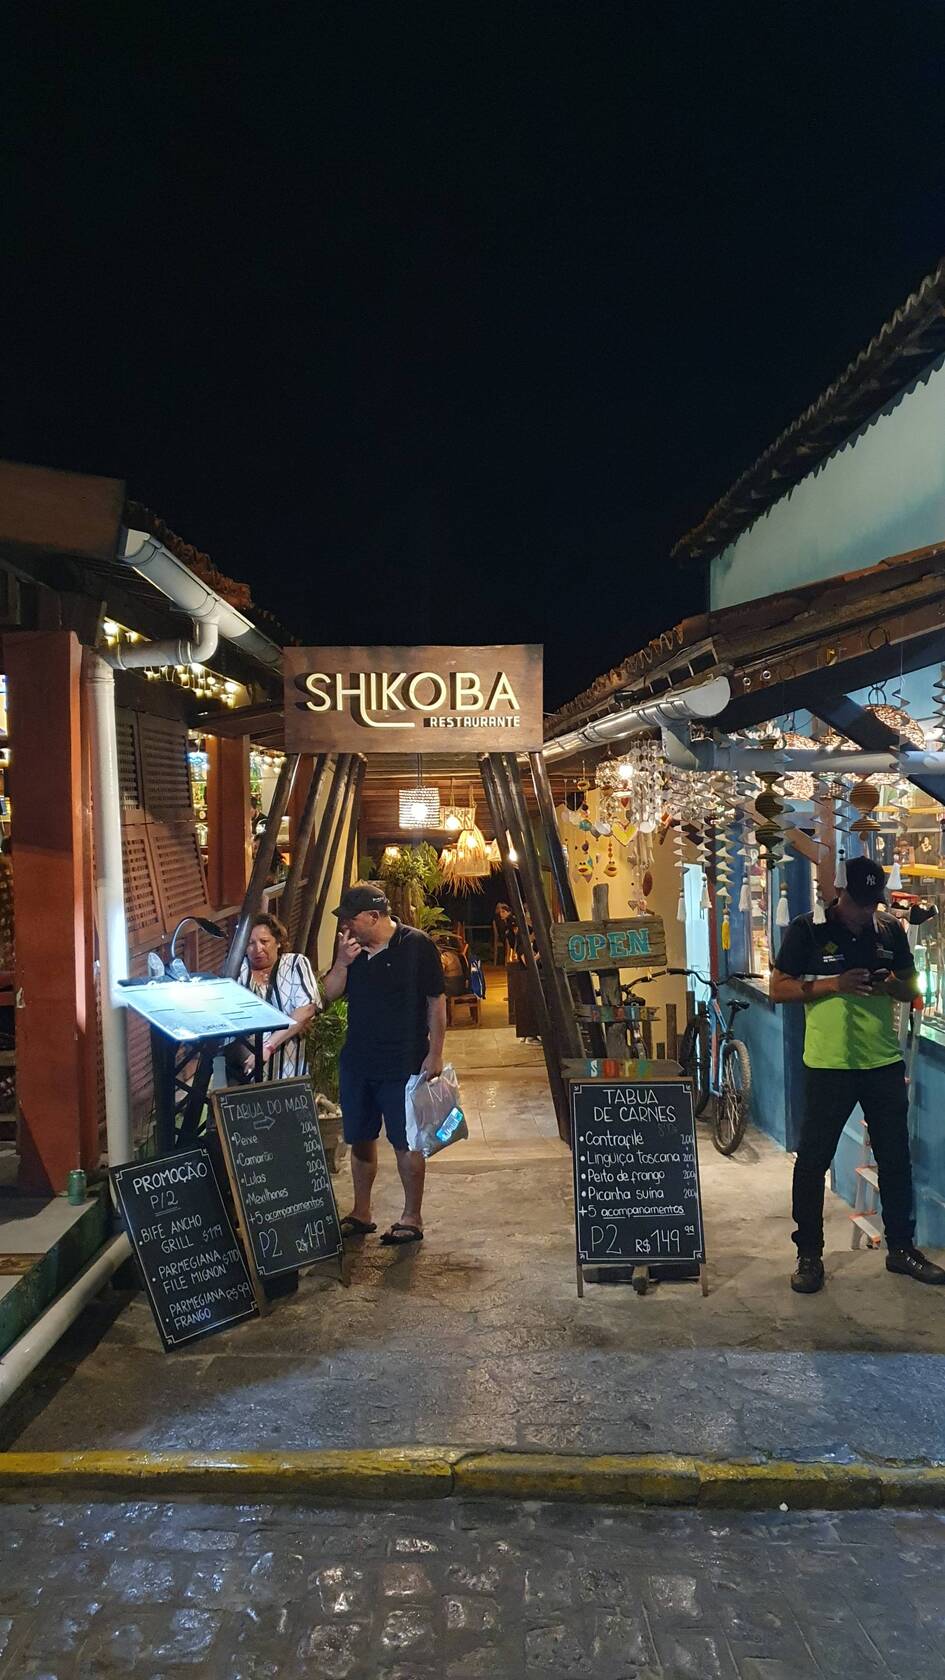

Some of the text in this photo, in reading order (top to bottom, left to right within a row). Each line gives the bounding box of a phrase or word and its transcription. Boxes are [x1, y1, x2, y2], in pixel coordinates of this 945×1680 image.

[305, 672, 520, 727] SHIKOBA
[429, 716, 520, 728] RESTAURANTE
[567, 928, 651, 963] OPEN
[267, 1100, 281, 1115] DO
[285, 1095, 309, 1112] MAR
[602, 1088, 659, 1105] TABUA
[593, 1105, 676, 1123] DE CARNES
[233, 1131, 258, 1146] Peixe
[587, 1151, 634, 1168] Linguiça
[132, 1161, 208, 1195] PROMOÇÃO
[243, 1171, 267, 1187] Lulas
[587, 1168, 614, 1183] Peito
[616, 1170, 629, 1182] de
[631, 1170, 665, 1184] frango
[150, 1190, 179, 1209] P/2
[587, 1186, 631, 1201] Picanha
[140, 1214, 202, 1243] BIFE ANCHO
[161, 1234, 194, 1254] GRILL
[258, 1228, 283, 1258] P2
[591, 1224, 622, 1255] P2
[159, 1250, 221, 1279] PARMEGIANA
[163, 1264, 227, 1294] FILE MIGNON
[169, 1288, 226, 1317] PARMEGIANA
[174, 1307, 212, 1331] FRANGO
